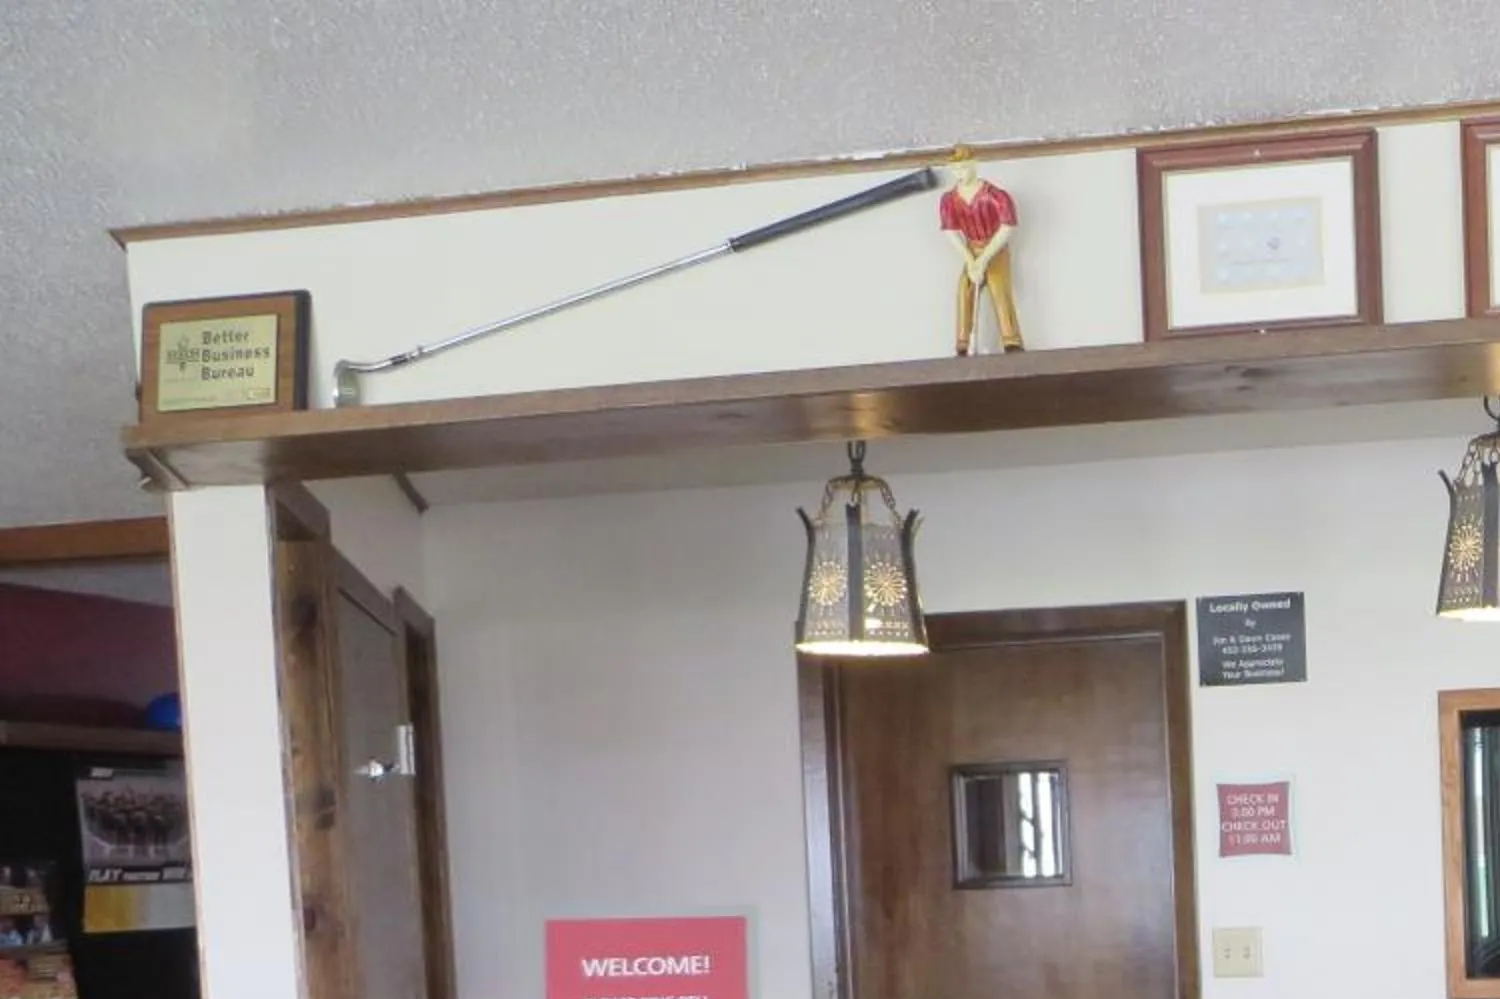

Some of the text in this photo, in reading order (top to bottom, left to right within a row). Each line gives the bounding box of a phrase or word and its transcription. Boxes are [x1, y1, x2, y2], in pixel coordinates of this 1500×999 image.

[201, 330, 250, 346] Better
[201, 346, 271, 364] Business
[201, 364, 256, 381] Bureau
[1208, 597, 1291, 614] Locally Owned
[1226, 792, 1266, 806] CHECK
[1257, 805, 1276, 817] PM
[1222, 819, 1286, 833] CHECK OUT
[1260, 832, 1281, 844] AM
[580, 955, 711, 977] WELCOME!
